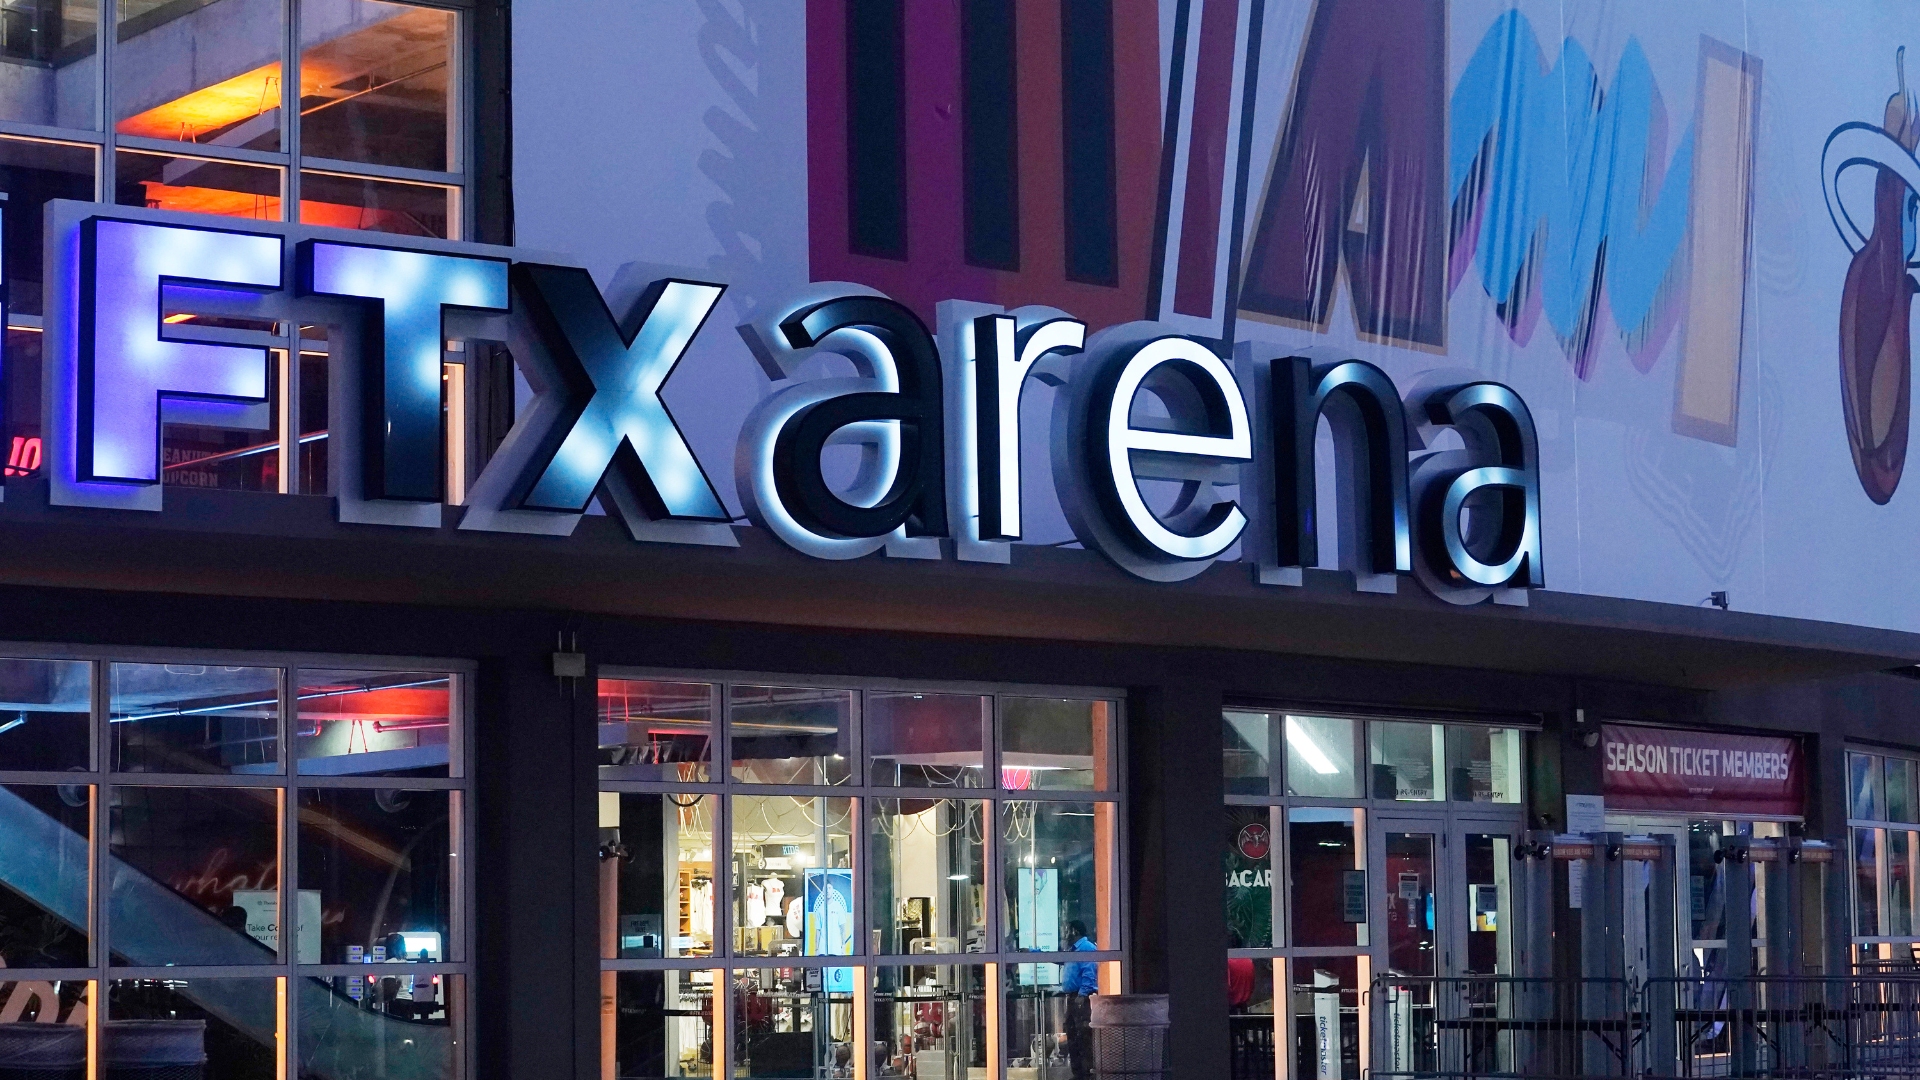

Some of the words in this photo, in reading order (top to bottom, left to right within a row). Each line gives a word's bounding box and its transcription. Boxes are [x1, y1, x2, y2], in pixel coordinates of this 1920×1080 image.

[76, 215, 733, 523] FTX
[774, 294, 1545, 589] arena
[163, 470, 219, 487] OPCORN
[1606, 741, 1668, 774] SEASON
[1670, 746, 1720, 776] TICKET
[1722, 750, 1789, 780] MEMBERS
[1225, 869, 1272, 888] ACAR
[247, 923, 266, 932] Take
